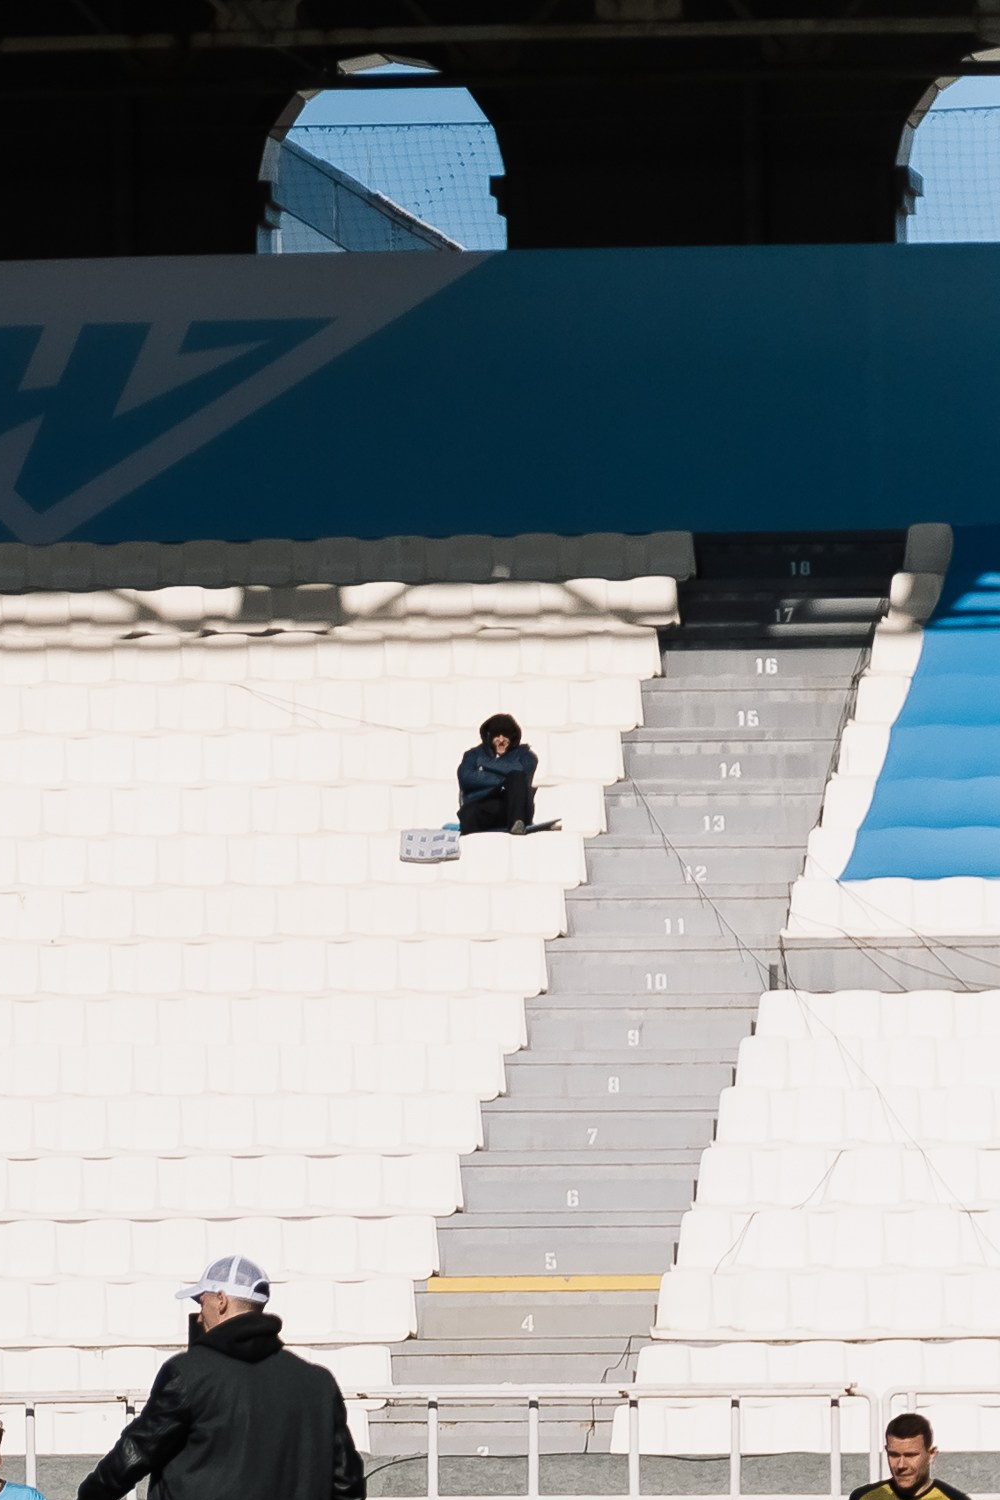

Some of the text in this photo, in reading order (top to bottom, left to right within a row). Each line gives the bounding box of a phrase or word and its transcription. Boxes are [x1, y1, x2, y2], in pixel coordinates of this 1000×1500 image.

[790, 561, 811, 576] 18
[774, 607, 795, 623] 17
[755, 658, 778, 675] 16
[737, 710, 759, 727] 15
[720, 762, 742, 779] 14
[703, 815, 725, 832] 13
[685, 865, 707, 883] 12
[664, 918, 685, 935] 11
[645, 973, 667, 990] 10
[627, 1029, 639, 1047] 9
[607, 1076, 620, 1093] 8
[587, 1127, 598, 1145] 7
[566, 1189, 579, 1207] 6
[545, 1252, 557, 1270] 5
[521, 1314, 534, 1332] 4
